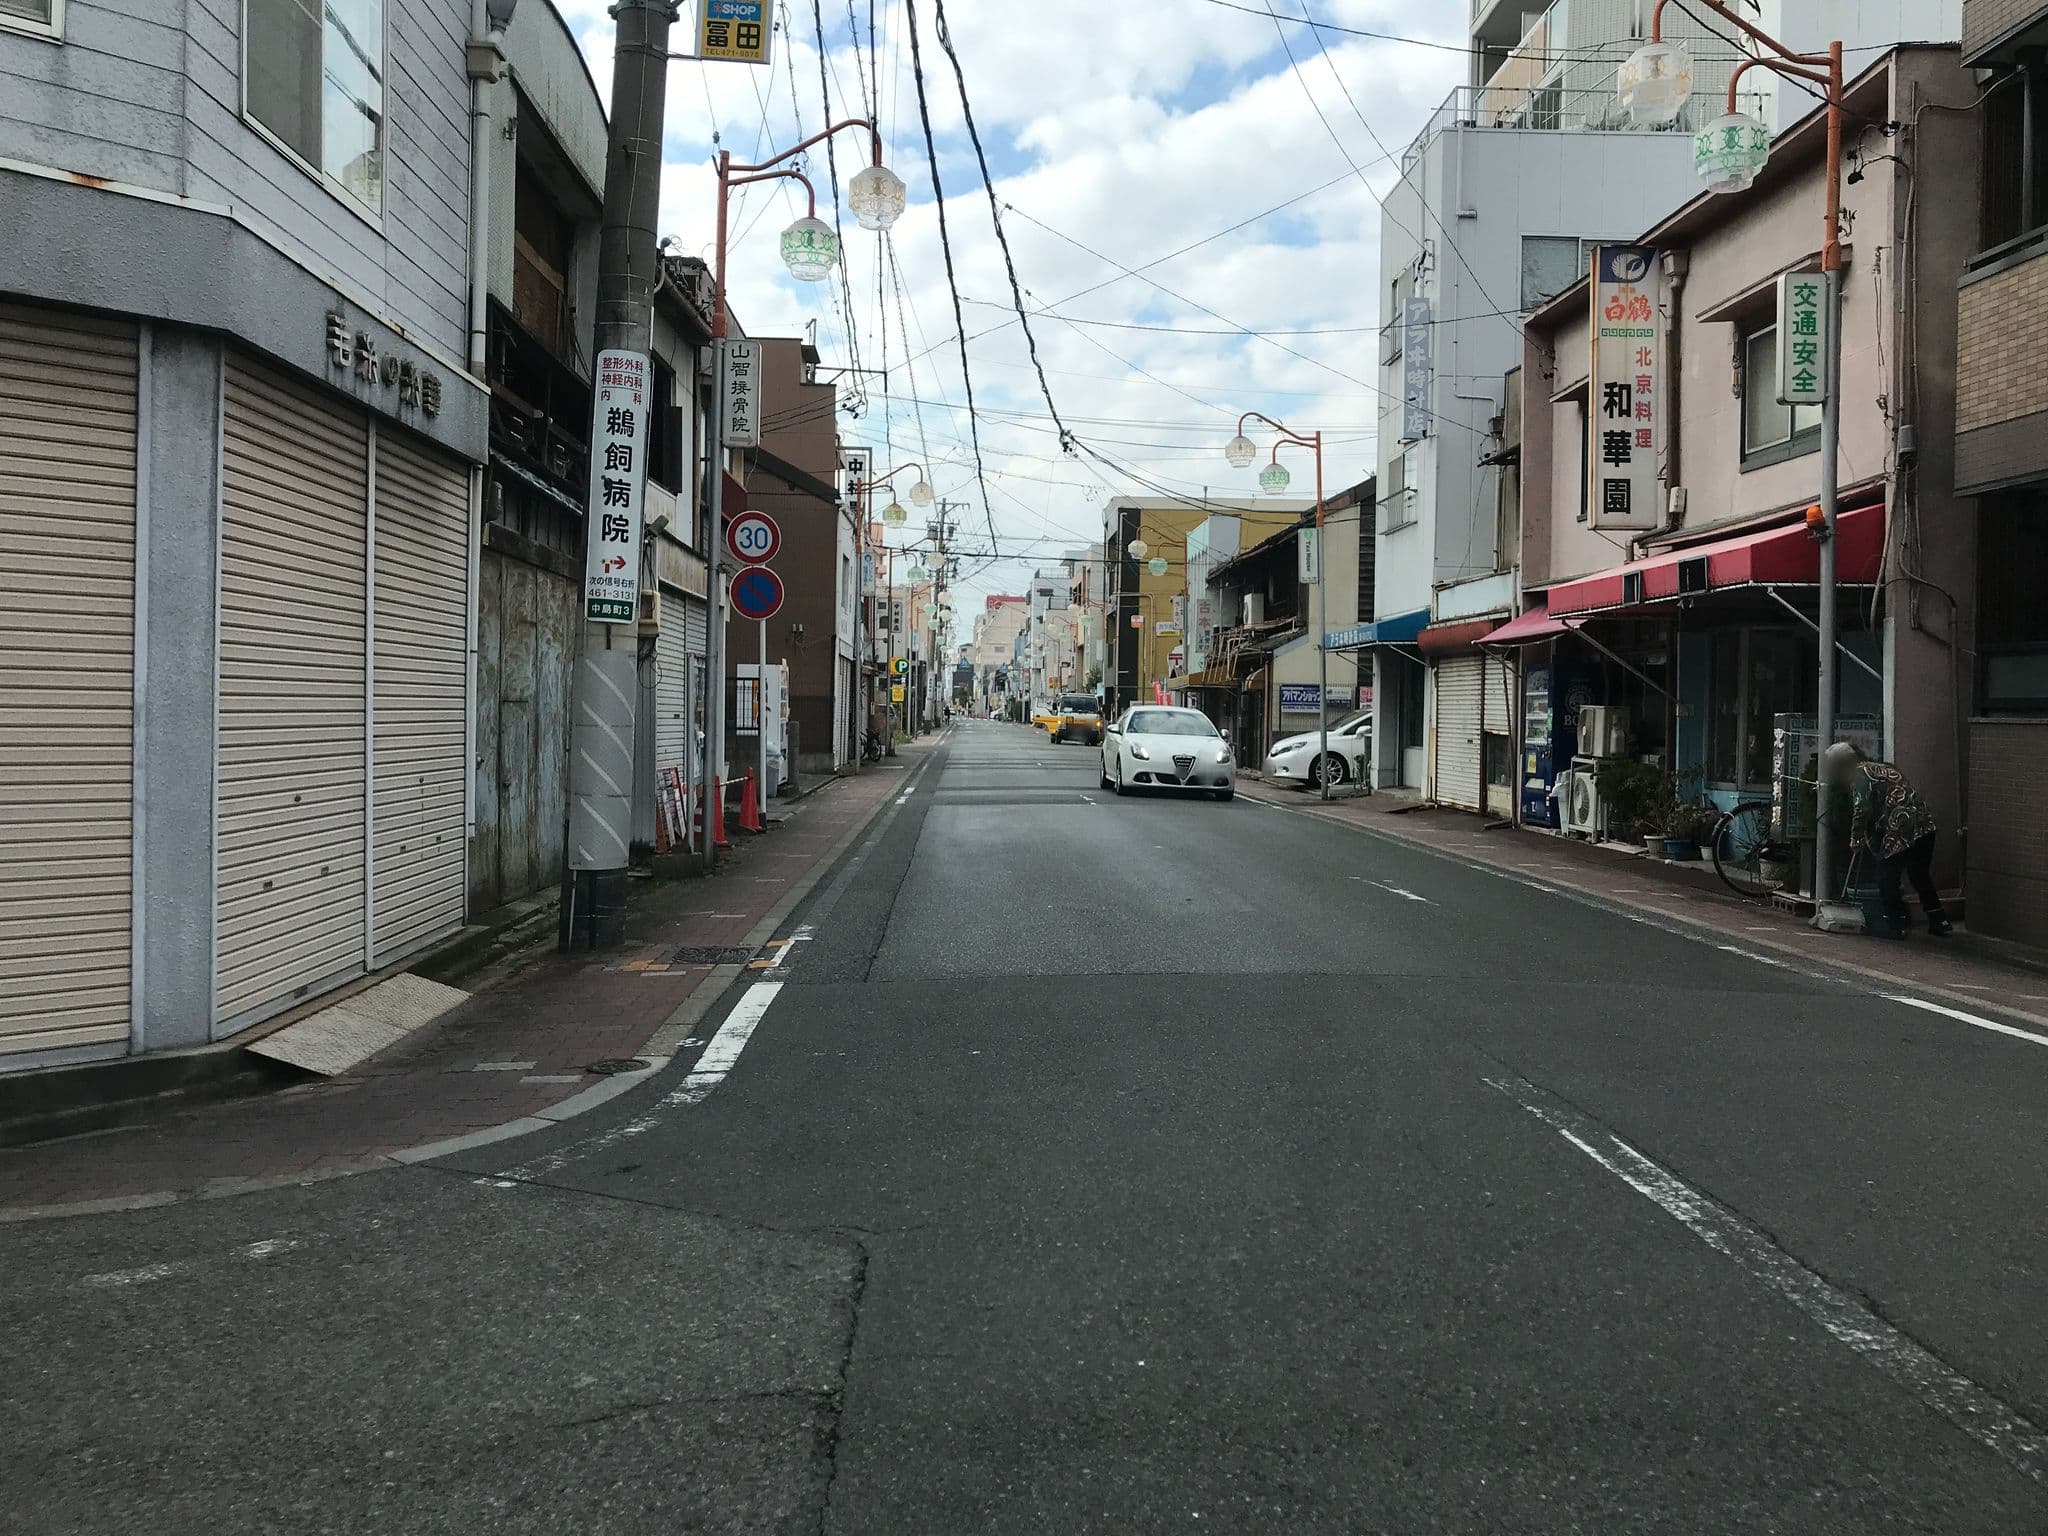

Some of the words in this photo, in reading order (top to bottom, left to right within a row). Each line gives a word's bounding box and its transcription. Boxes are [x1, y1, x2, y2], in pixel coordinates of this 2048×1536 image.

[1605, 294, 1652, 322] 白鶴
[1792, 283, 1818, 393] 交通安全
[602, 357, 643, 374] 整形外科
[601, 373, 642, 390] 神経内科
[730, 344, 751, 433] 山智接骨院
[1635, 346, 1652, 448] 北京料理
[1603, 382, 1632, 514] 和華園
[602, 407, 635, 543] 鵜飼病院
[740, 526, 768, 550] 30
[589, 576, 635, 588] 次の信号右折
[589, 588, 635, 600] 461-3131
[592, 602, 630, 616] 中島町3
[898, 660, 908, 672] P
